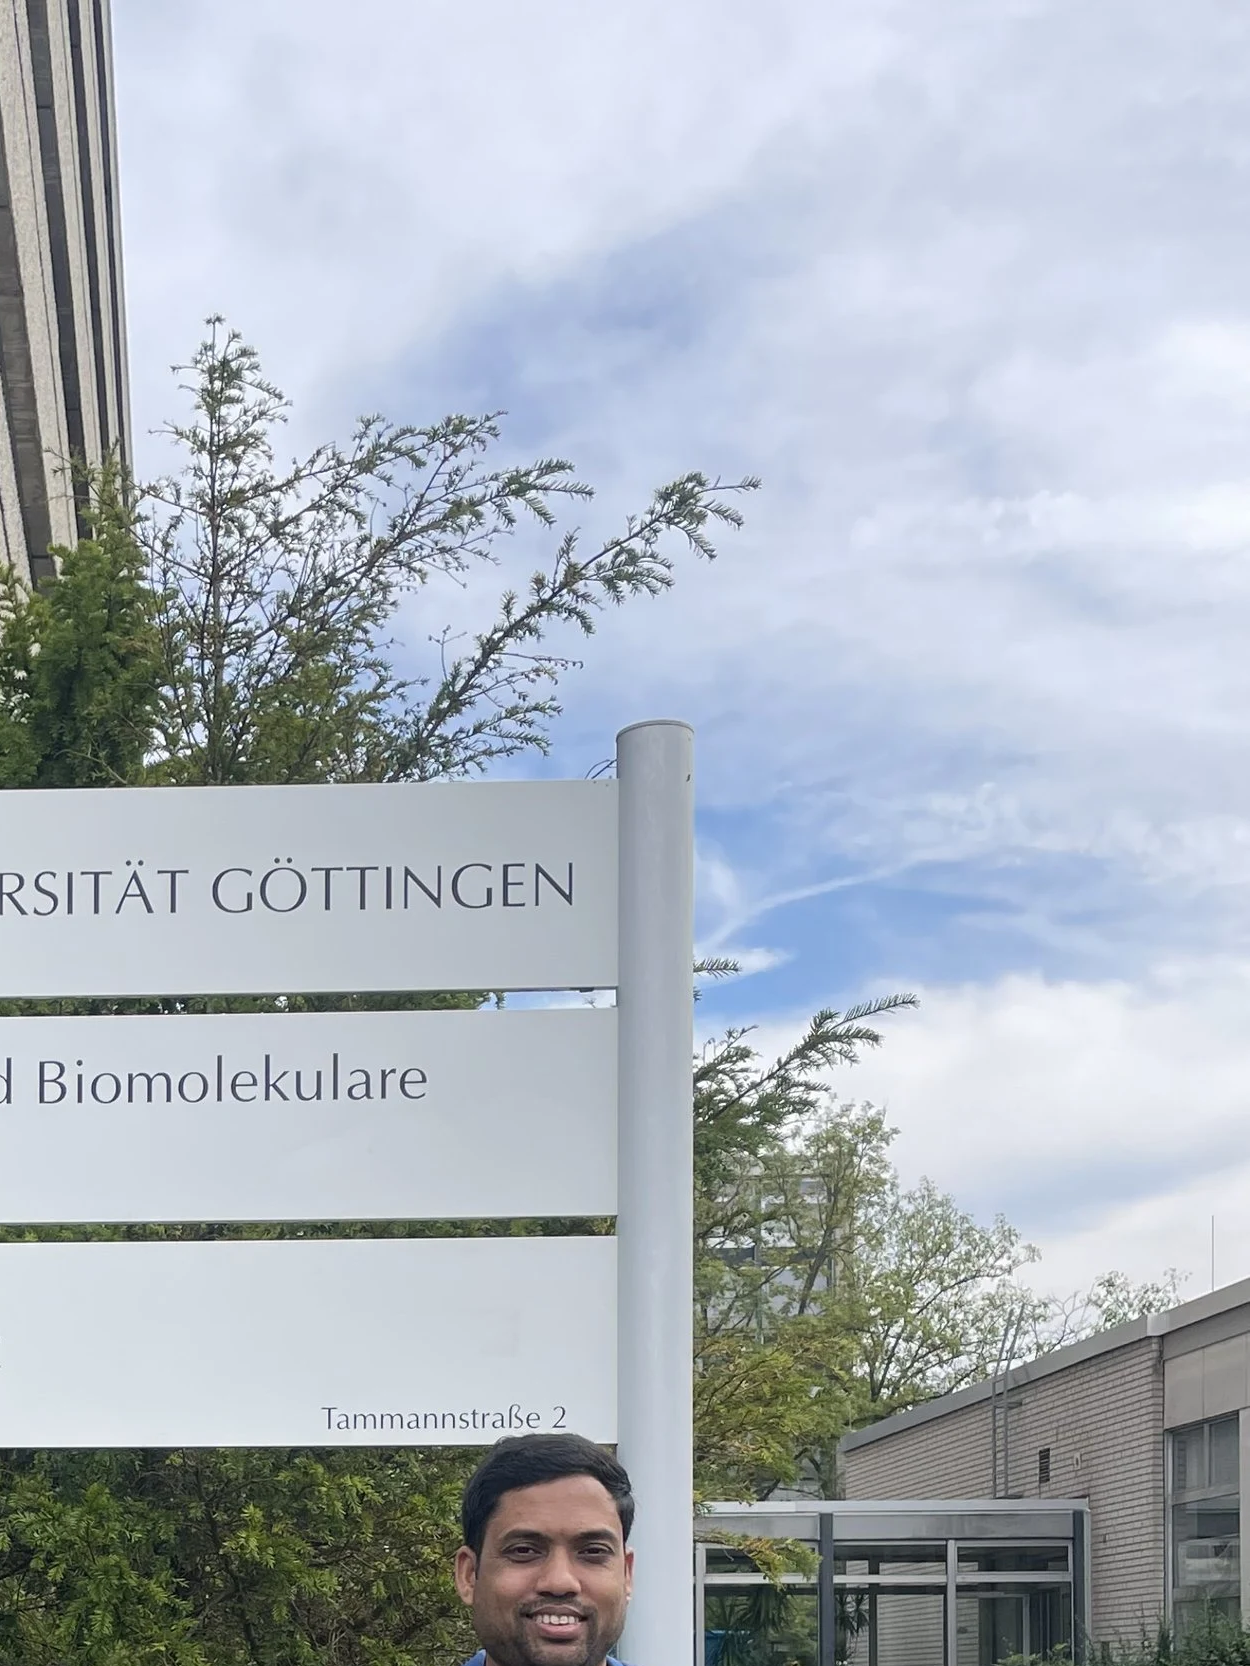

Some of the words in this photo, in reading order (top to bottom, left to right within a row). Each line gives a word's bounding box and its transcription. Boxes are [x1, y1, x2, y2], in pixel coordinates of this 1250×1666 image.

[212, 857, 575, 914] GÖTTINGEN
[39, 1053, 429, 1106] Biomolekulare
[321, 1403, 542, 1431] Tammannstraße
[552, 1406, 568, 1430] 2
